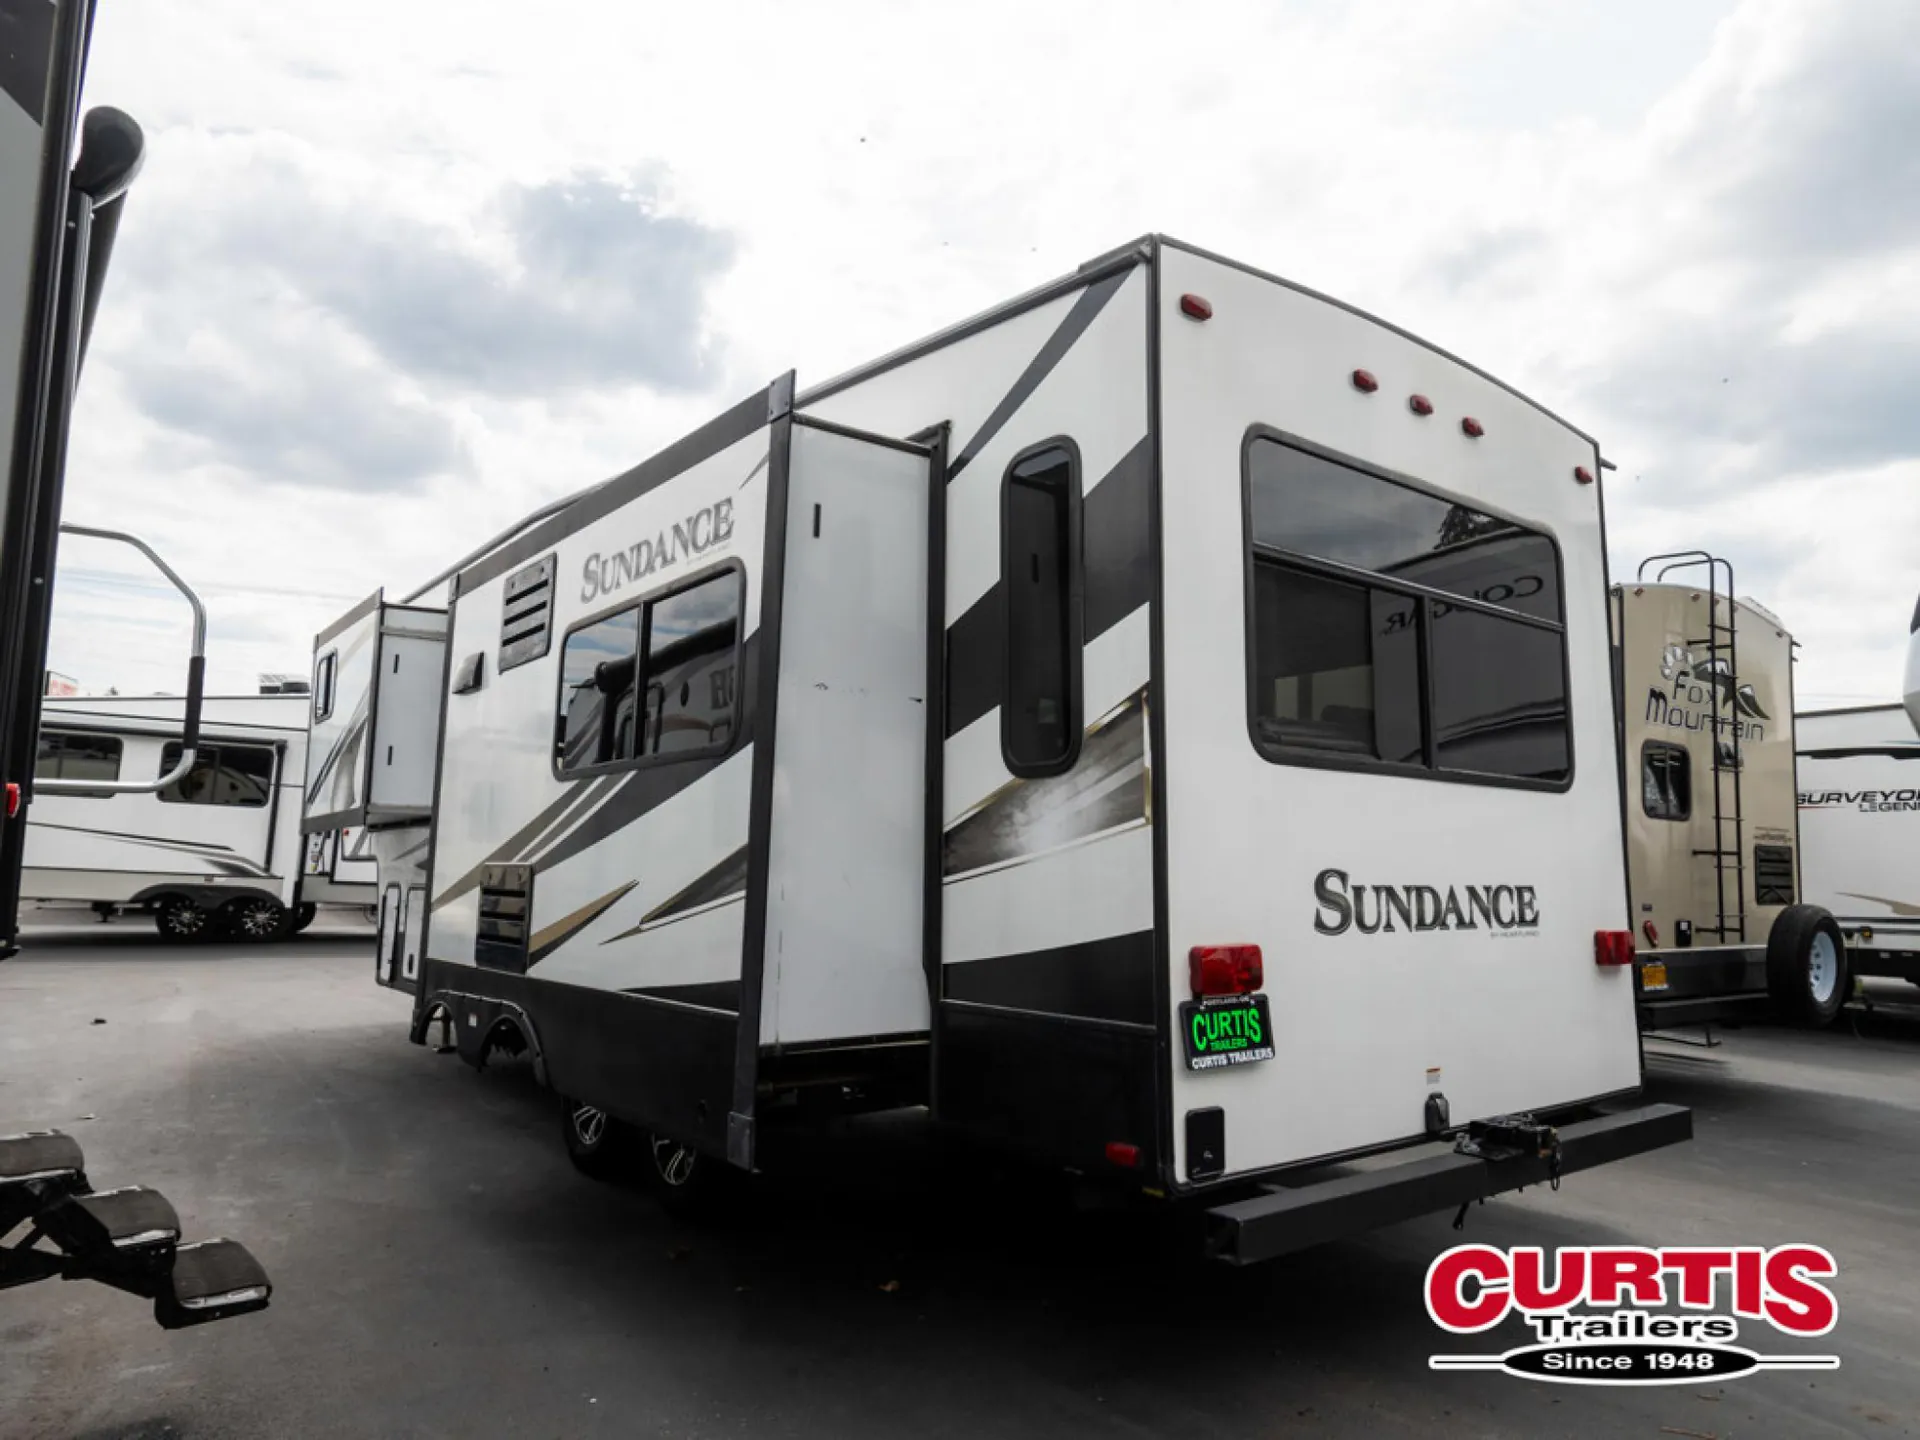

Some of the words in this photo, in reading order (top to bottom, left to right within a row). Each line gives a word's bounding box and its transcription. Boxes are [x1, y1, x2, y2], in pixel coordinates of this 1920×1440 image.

[580, 497, 735, 604] SUNDANCE
[1797, 788, 1920, 805] SURVEYO
[1313, 867, 1540, 936] SUNDANCE
[1192, 1008, 1262, 1051] CURTIS
[1192, 1053, 1228, 1069] CURTIS
[1228, 1047, 1274, 1064] TRAILERS
